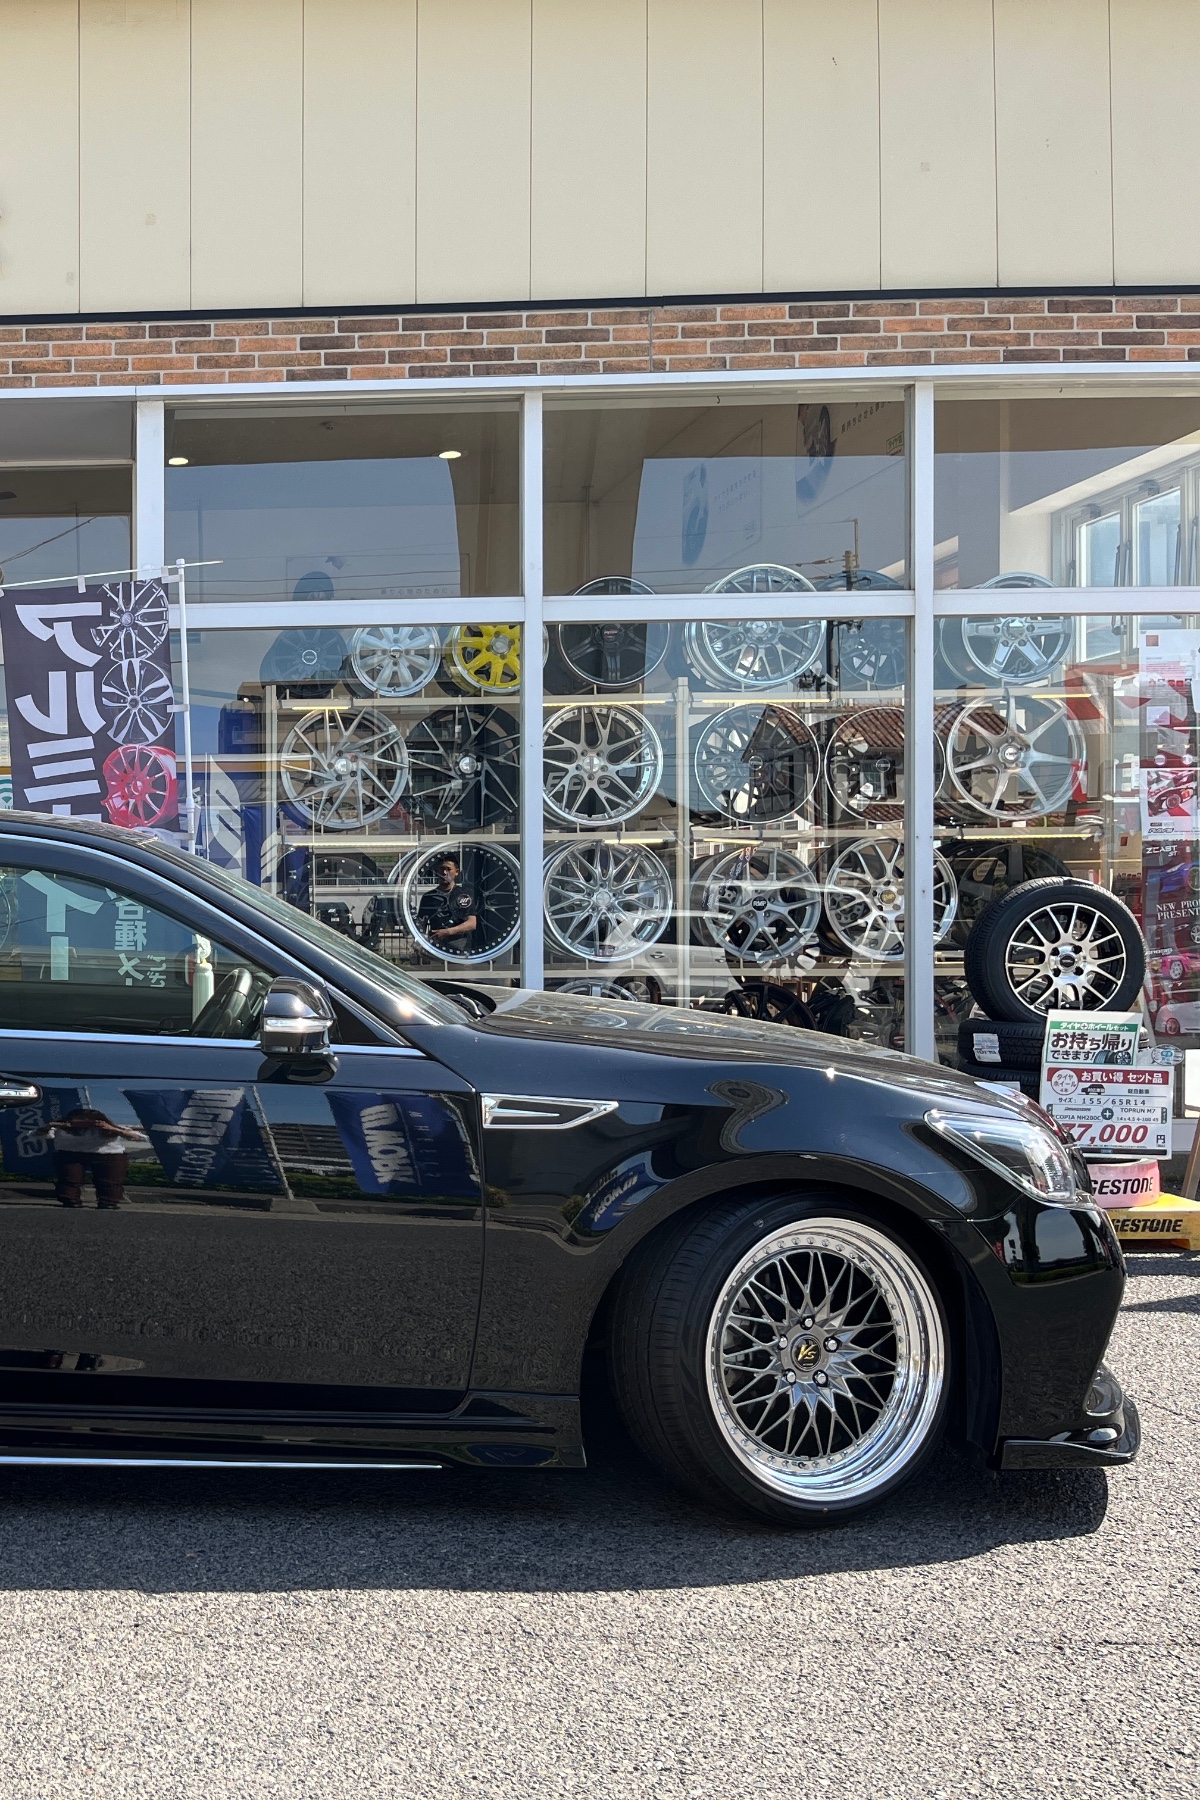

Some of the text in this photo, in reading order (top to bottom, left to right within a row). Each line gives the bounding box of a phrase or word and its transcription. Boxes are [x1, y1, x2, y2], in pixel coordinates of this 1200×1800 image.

[1156, 899, 1200, 912] NEW PRO
[1050, 1032, 1133, 1052] お持ち帰り
[1050, 1049, 1096, 1061] できます!
[1081, 1071, 1163, 1084] お買い得 セット品
[1156, 1134, 1166, 1144] 円
